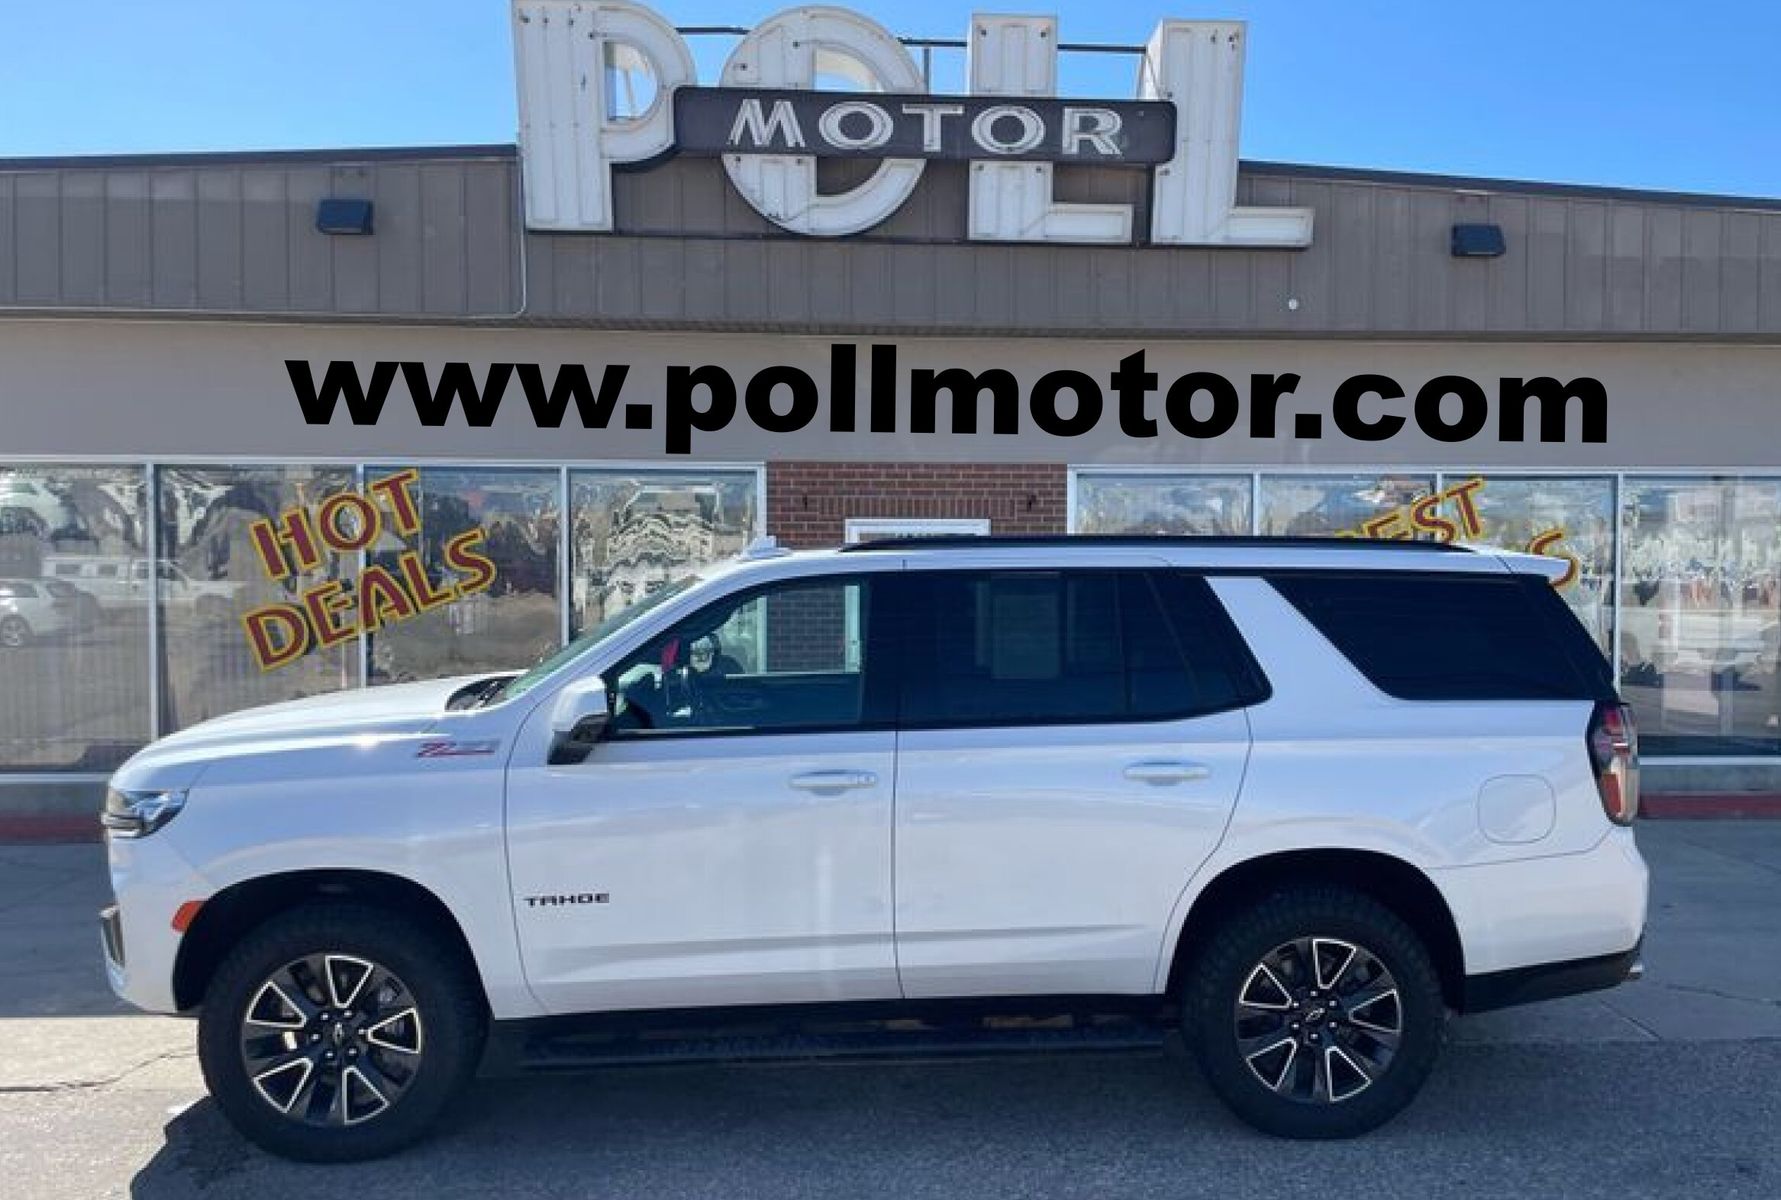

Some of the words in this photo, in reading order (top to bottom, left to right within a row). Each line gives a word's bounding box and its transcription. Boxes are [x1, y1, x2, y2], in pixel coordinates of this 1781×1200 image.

[514, 0, 1314, 246] POLL
[727, 98, 1123, 156] MOTOR
[250, 468, 420, 580] HOT
[1333, 475, 1487, 543] ST
[244, 527, 496, 672] DEALS
[523, 892, 610, 908] TAHOE
